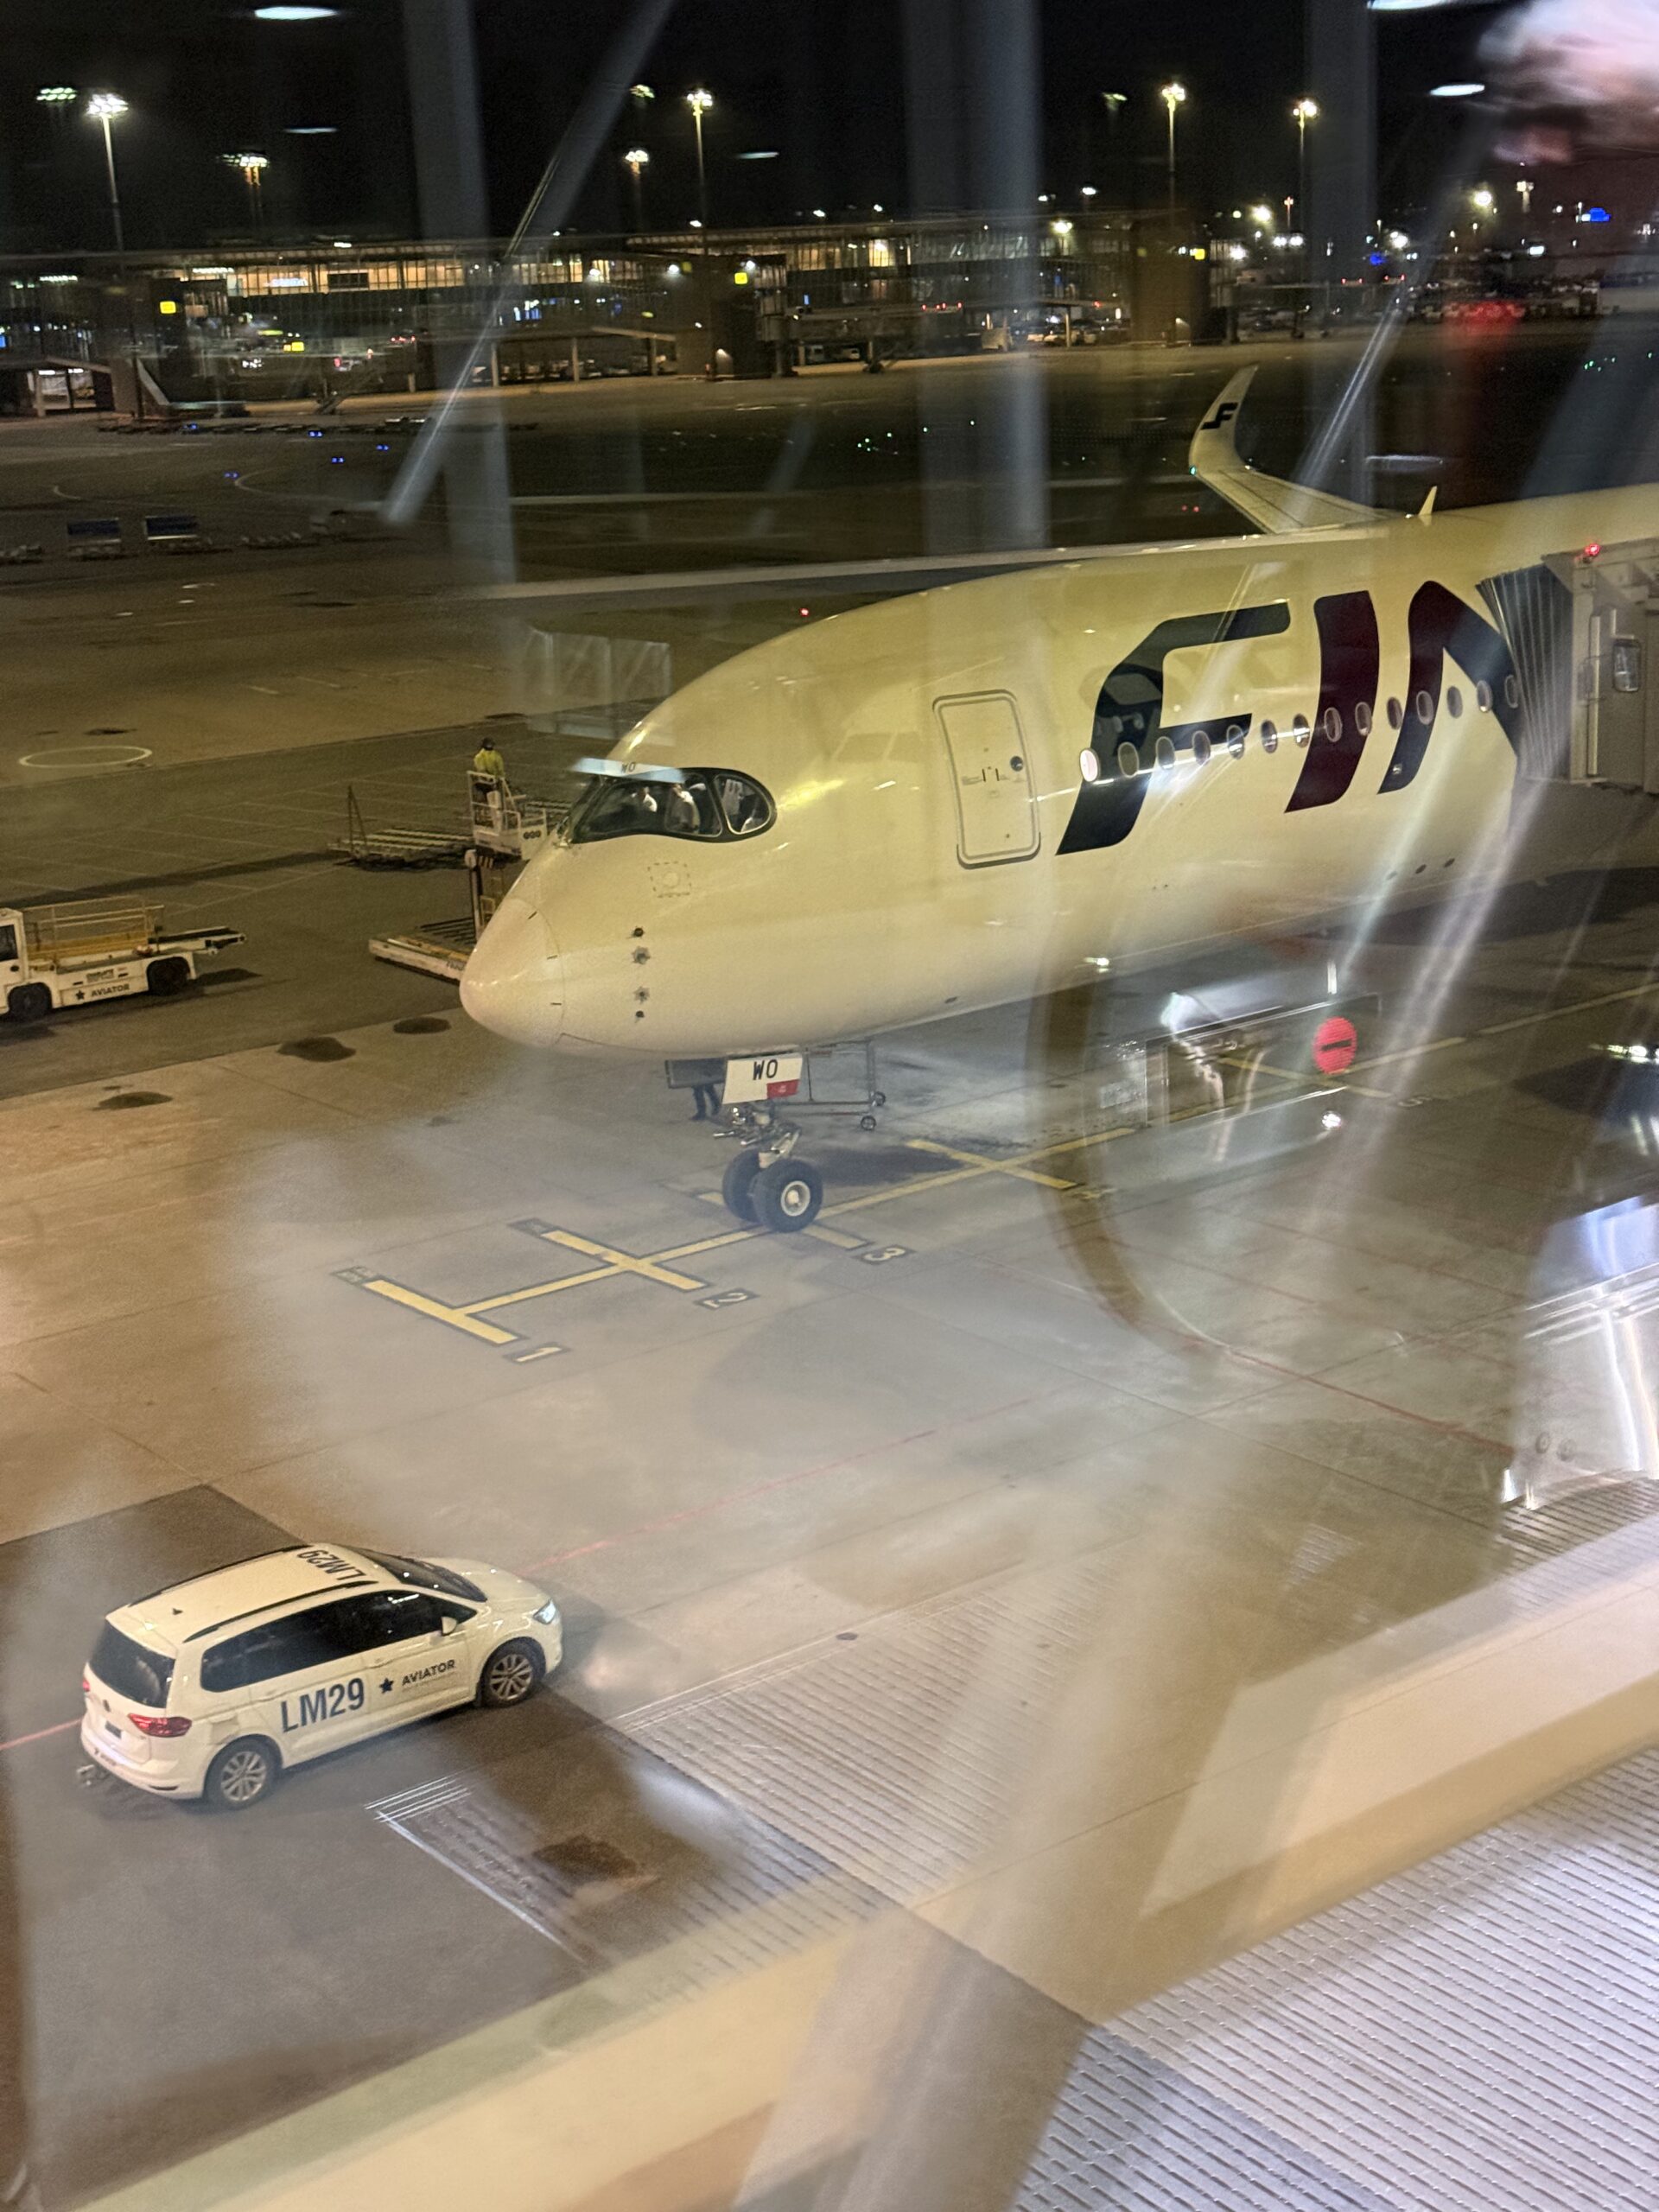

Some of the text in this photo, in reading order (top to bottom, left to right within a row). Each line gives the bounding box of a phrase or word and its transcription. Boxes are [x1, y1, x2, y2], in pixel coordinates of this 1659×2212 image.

[92, 983, 130, 997] AVIATOR
[753, 1058, 779, 1081] WO
[864, 1247, 906, 1262] 3
[703, 1292, 748, 1308] 2
[516, 1346, 562, 1363] 1
[296, 1549, 367, 1581] LM29
[402, 1659, 456, 1687] AVIATOR
[280, 1677, 365, 1733] LM29
